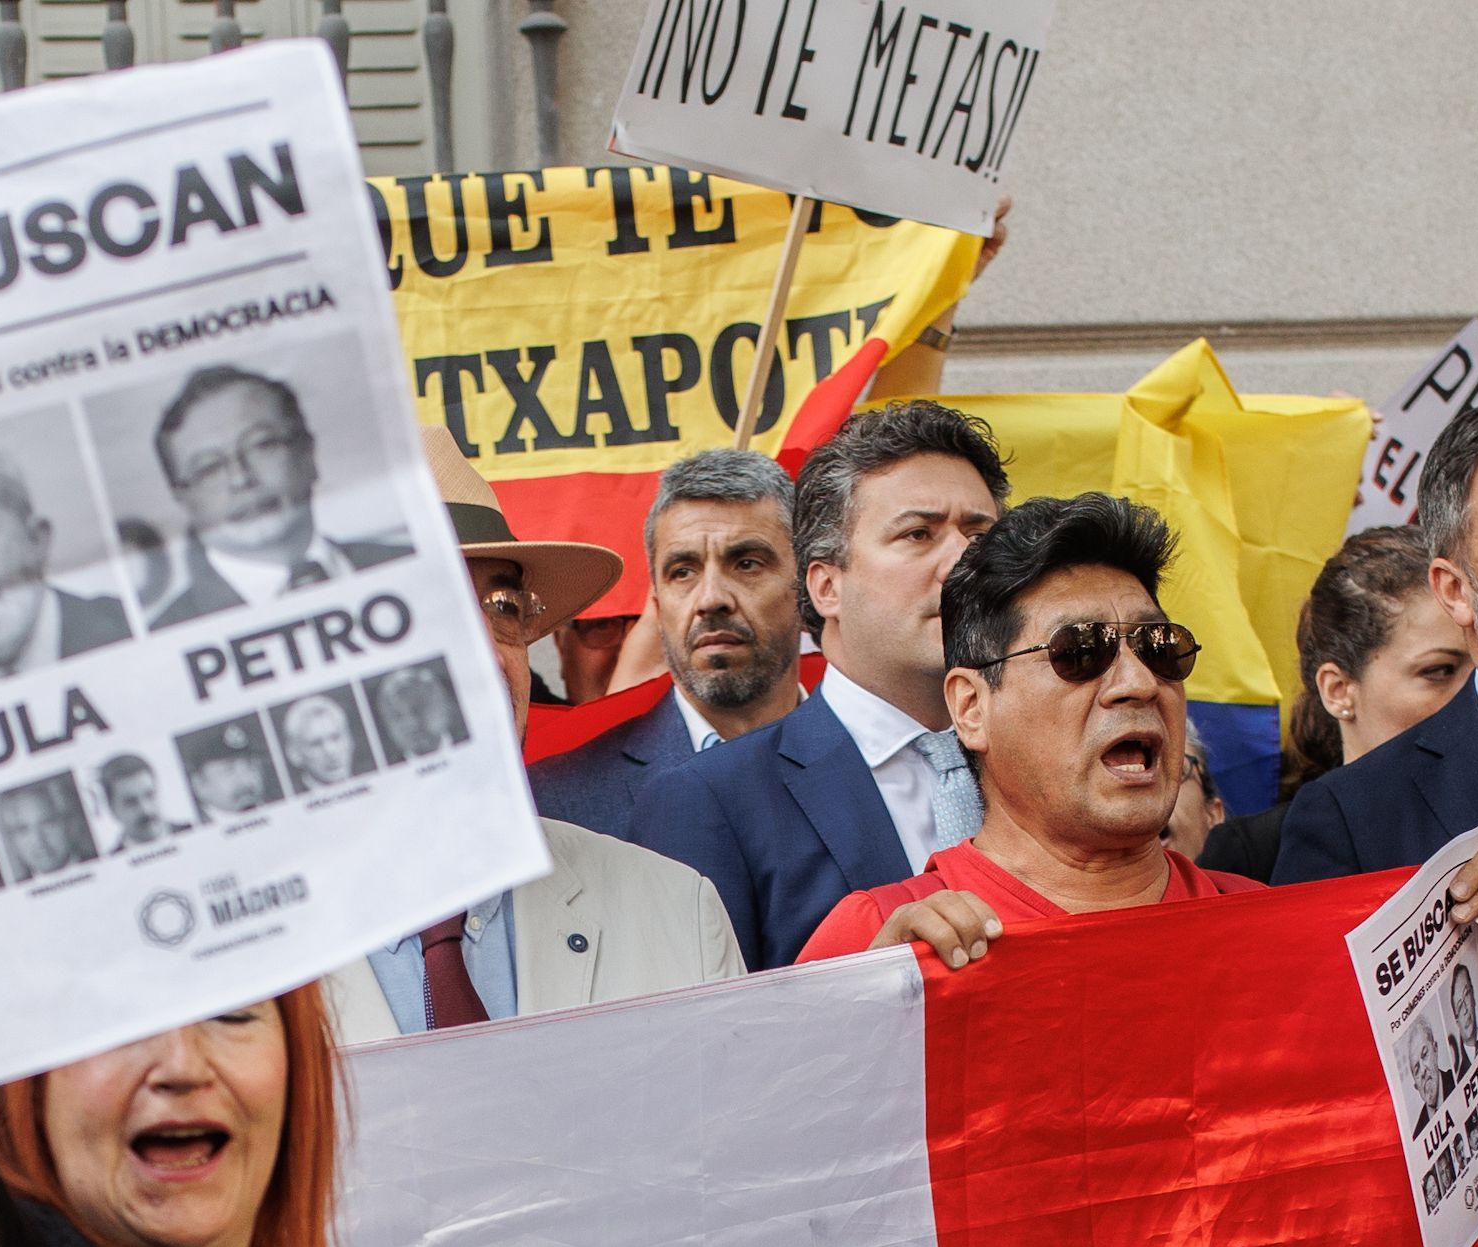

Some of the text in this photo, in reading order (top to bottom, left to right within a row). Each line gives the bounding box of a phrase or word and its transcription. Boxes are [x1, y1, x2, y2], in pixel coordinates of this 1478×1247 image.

[8, 349, 98, 387] contra
[103, 337, 129, 361] la
[136, 285, 337, 353] DEMOCRACIA
[1374, 437, 1420, 506] EL
[184, 593, 414, 701] PETRO
[210, 875, 309, 926] MADRID
[1376, 888, 1456, 997] SE BUSCA
[1390, 1017, 1402, 1033] Por
[1424, 1109, 1455, 1160] LULA
